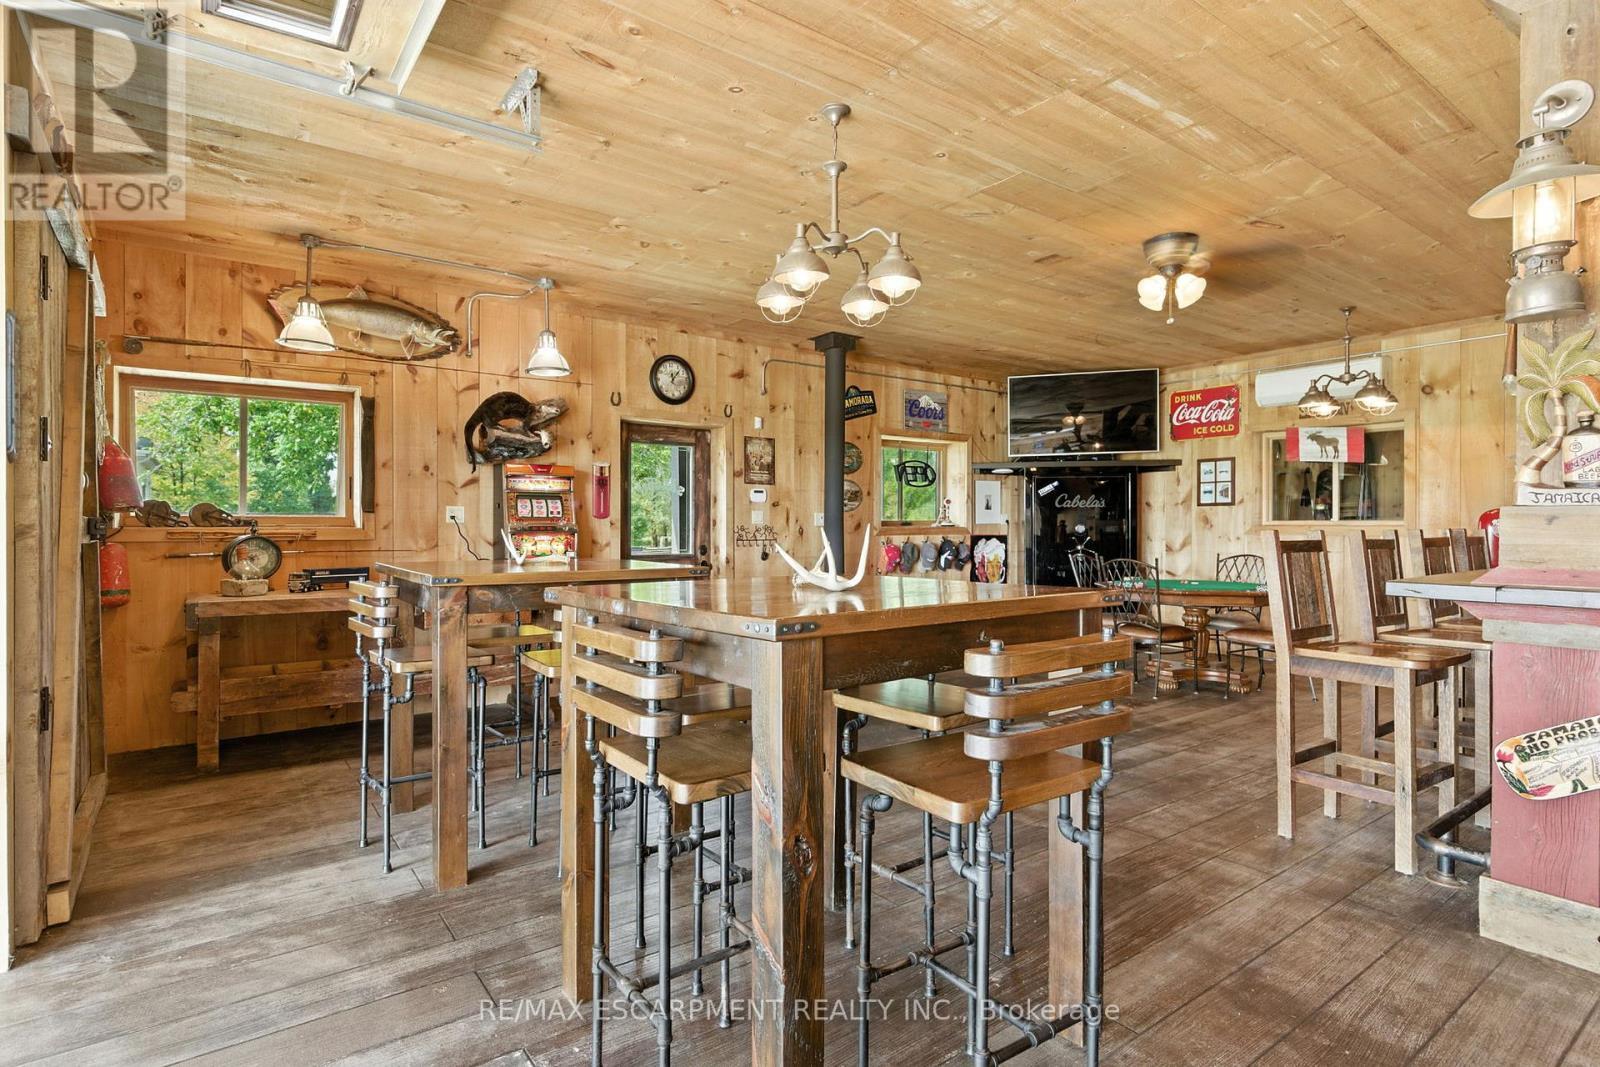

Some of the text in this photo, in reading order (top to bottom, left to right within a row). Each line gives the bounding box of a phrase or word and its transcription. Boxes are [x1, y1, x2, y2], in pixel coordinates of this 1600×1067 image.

[1174, 394, 1202, 404] DRINK
[908, 399, 945, 420] Coors
[1193, 424, 1235, 435] ICE COLD
[1528, 492, 1600, 503] JAMAICA
[1523, 717, 1600, 744] JAMAI
[1527, 740, 1550, 753] NO
